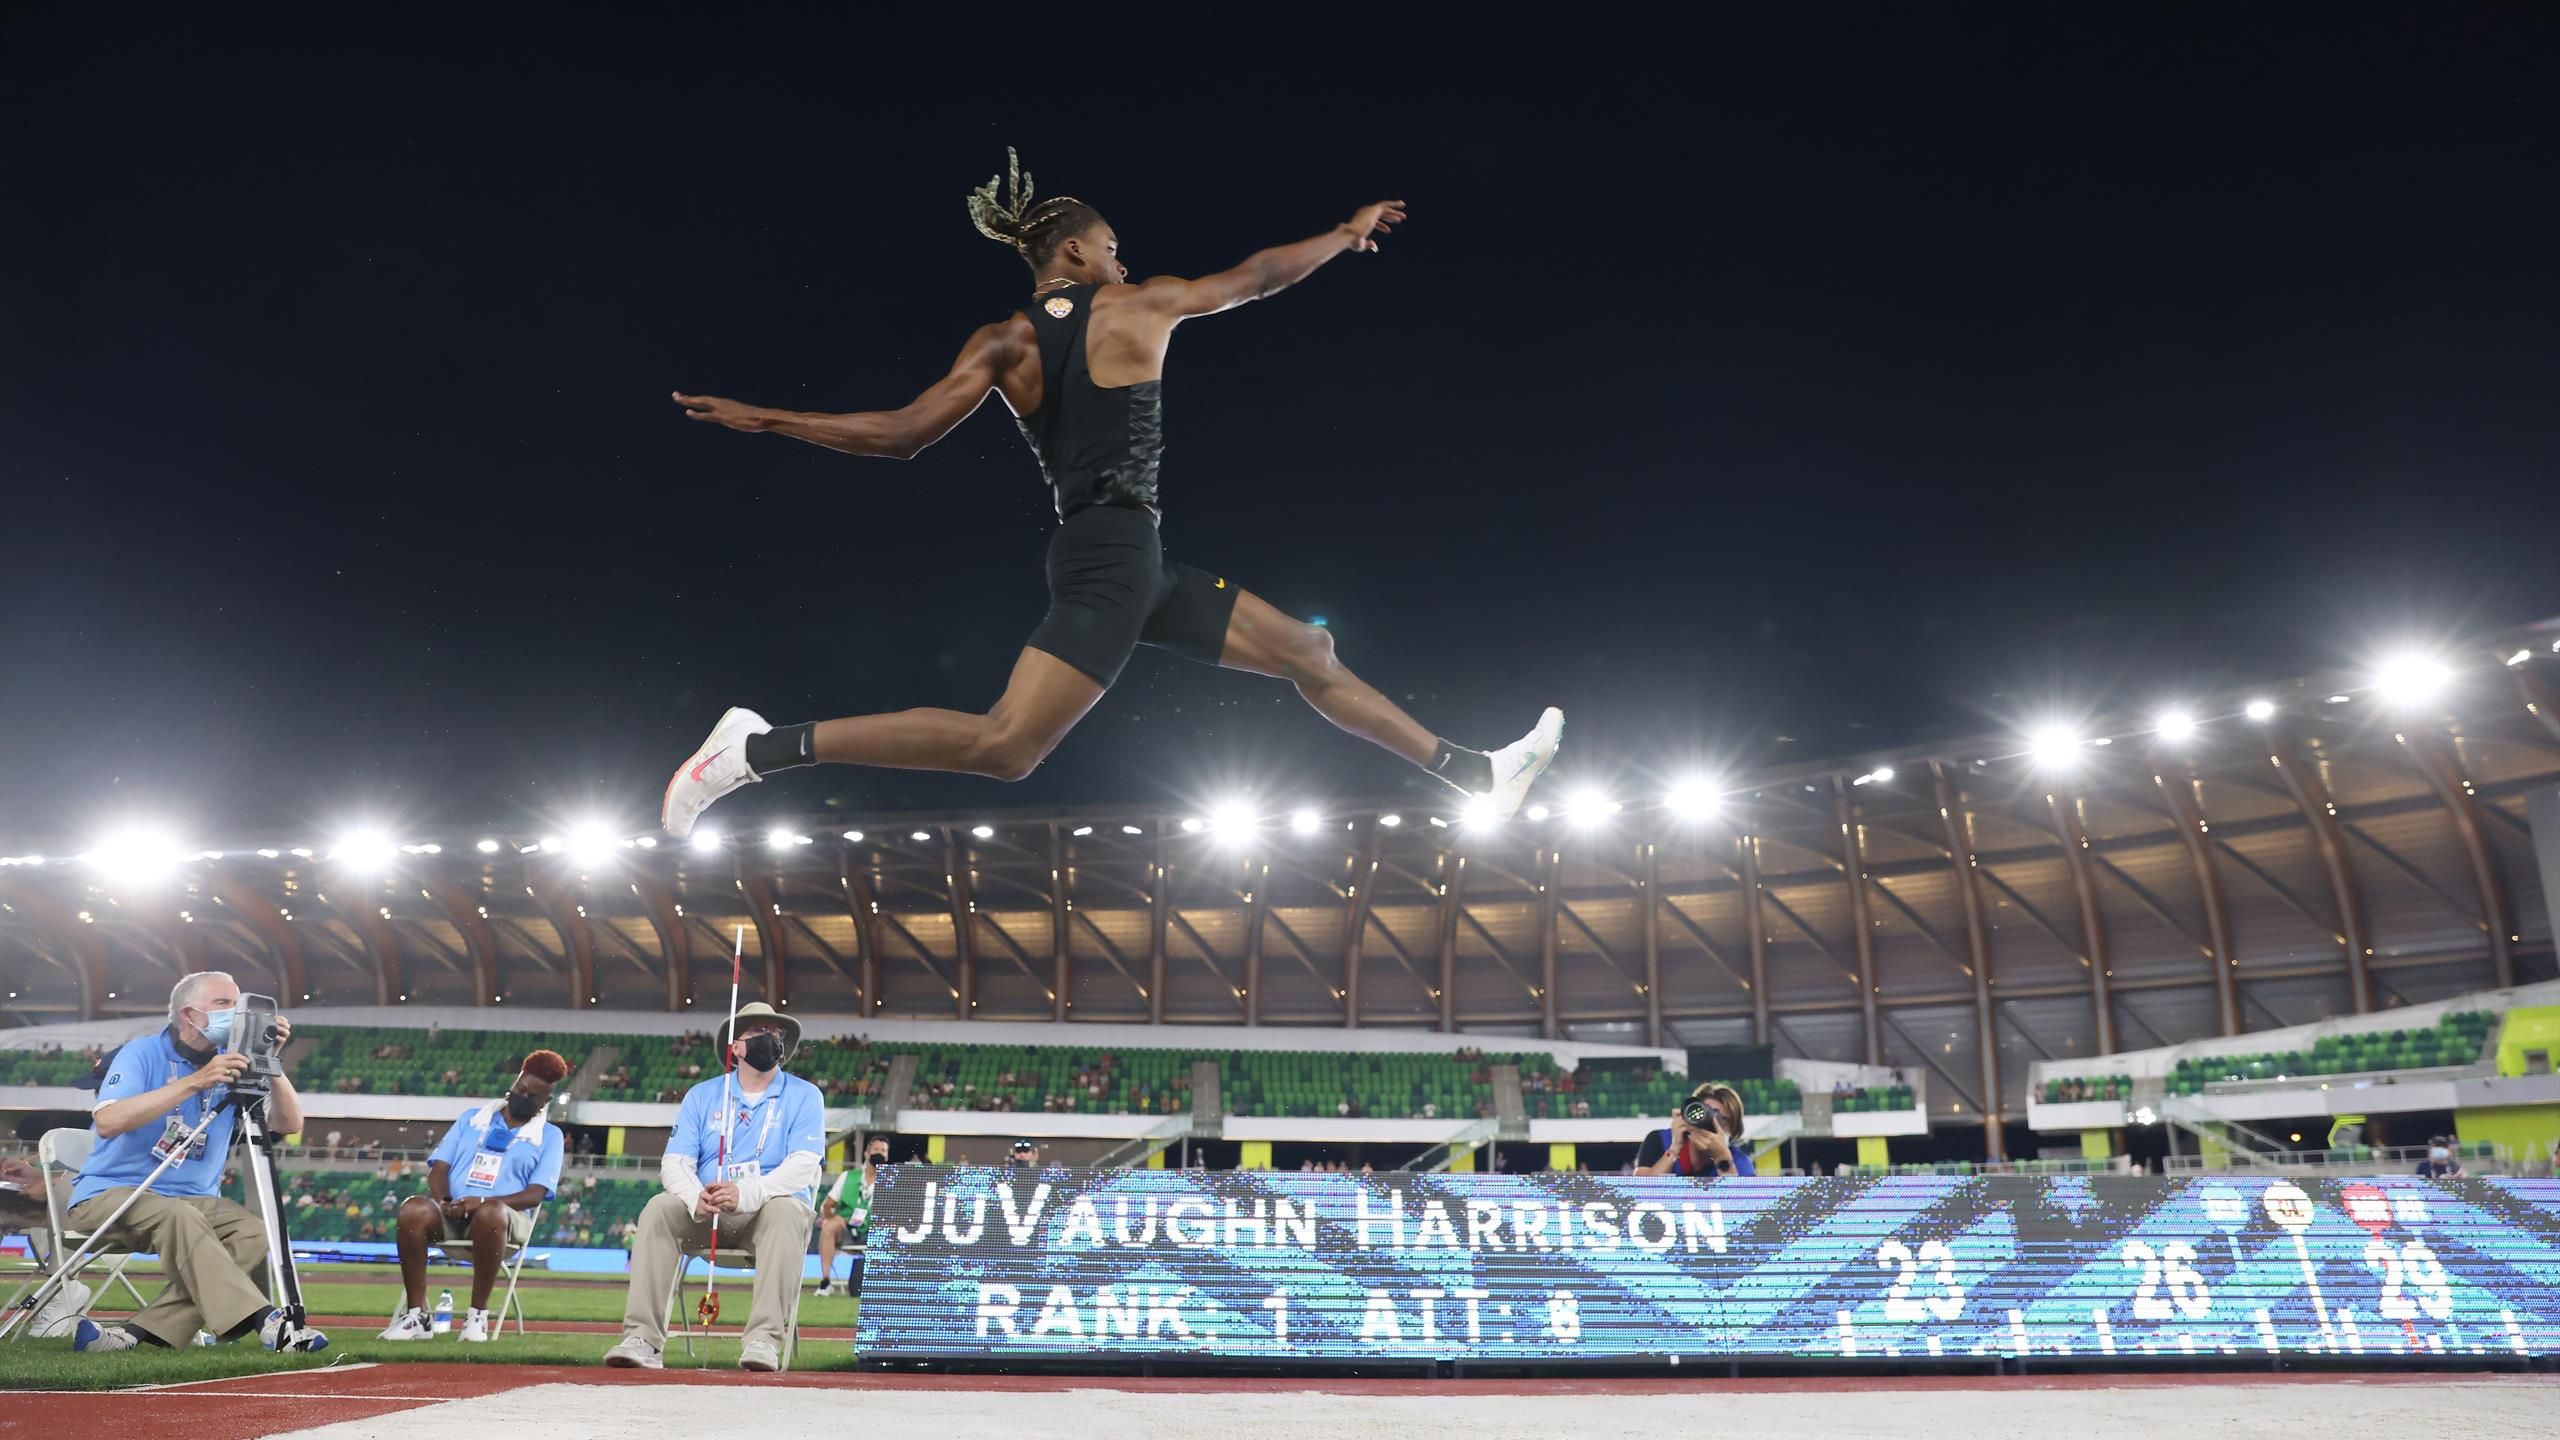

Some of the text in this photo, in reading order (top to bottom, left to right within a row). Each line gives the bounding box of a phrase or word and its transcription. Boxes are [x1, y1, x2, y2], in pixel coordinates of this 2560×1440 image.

[1357, 1188, 1728, 1253] HARRISON
[976, 1283, 1218, 1341] RANK:
[1263, 1287, 1288, 1341] 1
[1360, 1288, 1514, 1343] ATT:
[1877, 1240, 1966, 1321] 23
[2121, 1240, 2212, 1320] 26
[2363, 1240, 2453, 1320] 29
